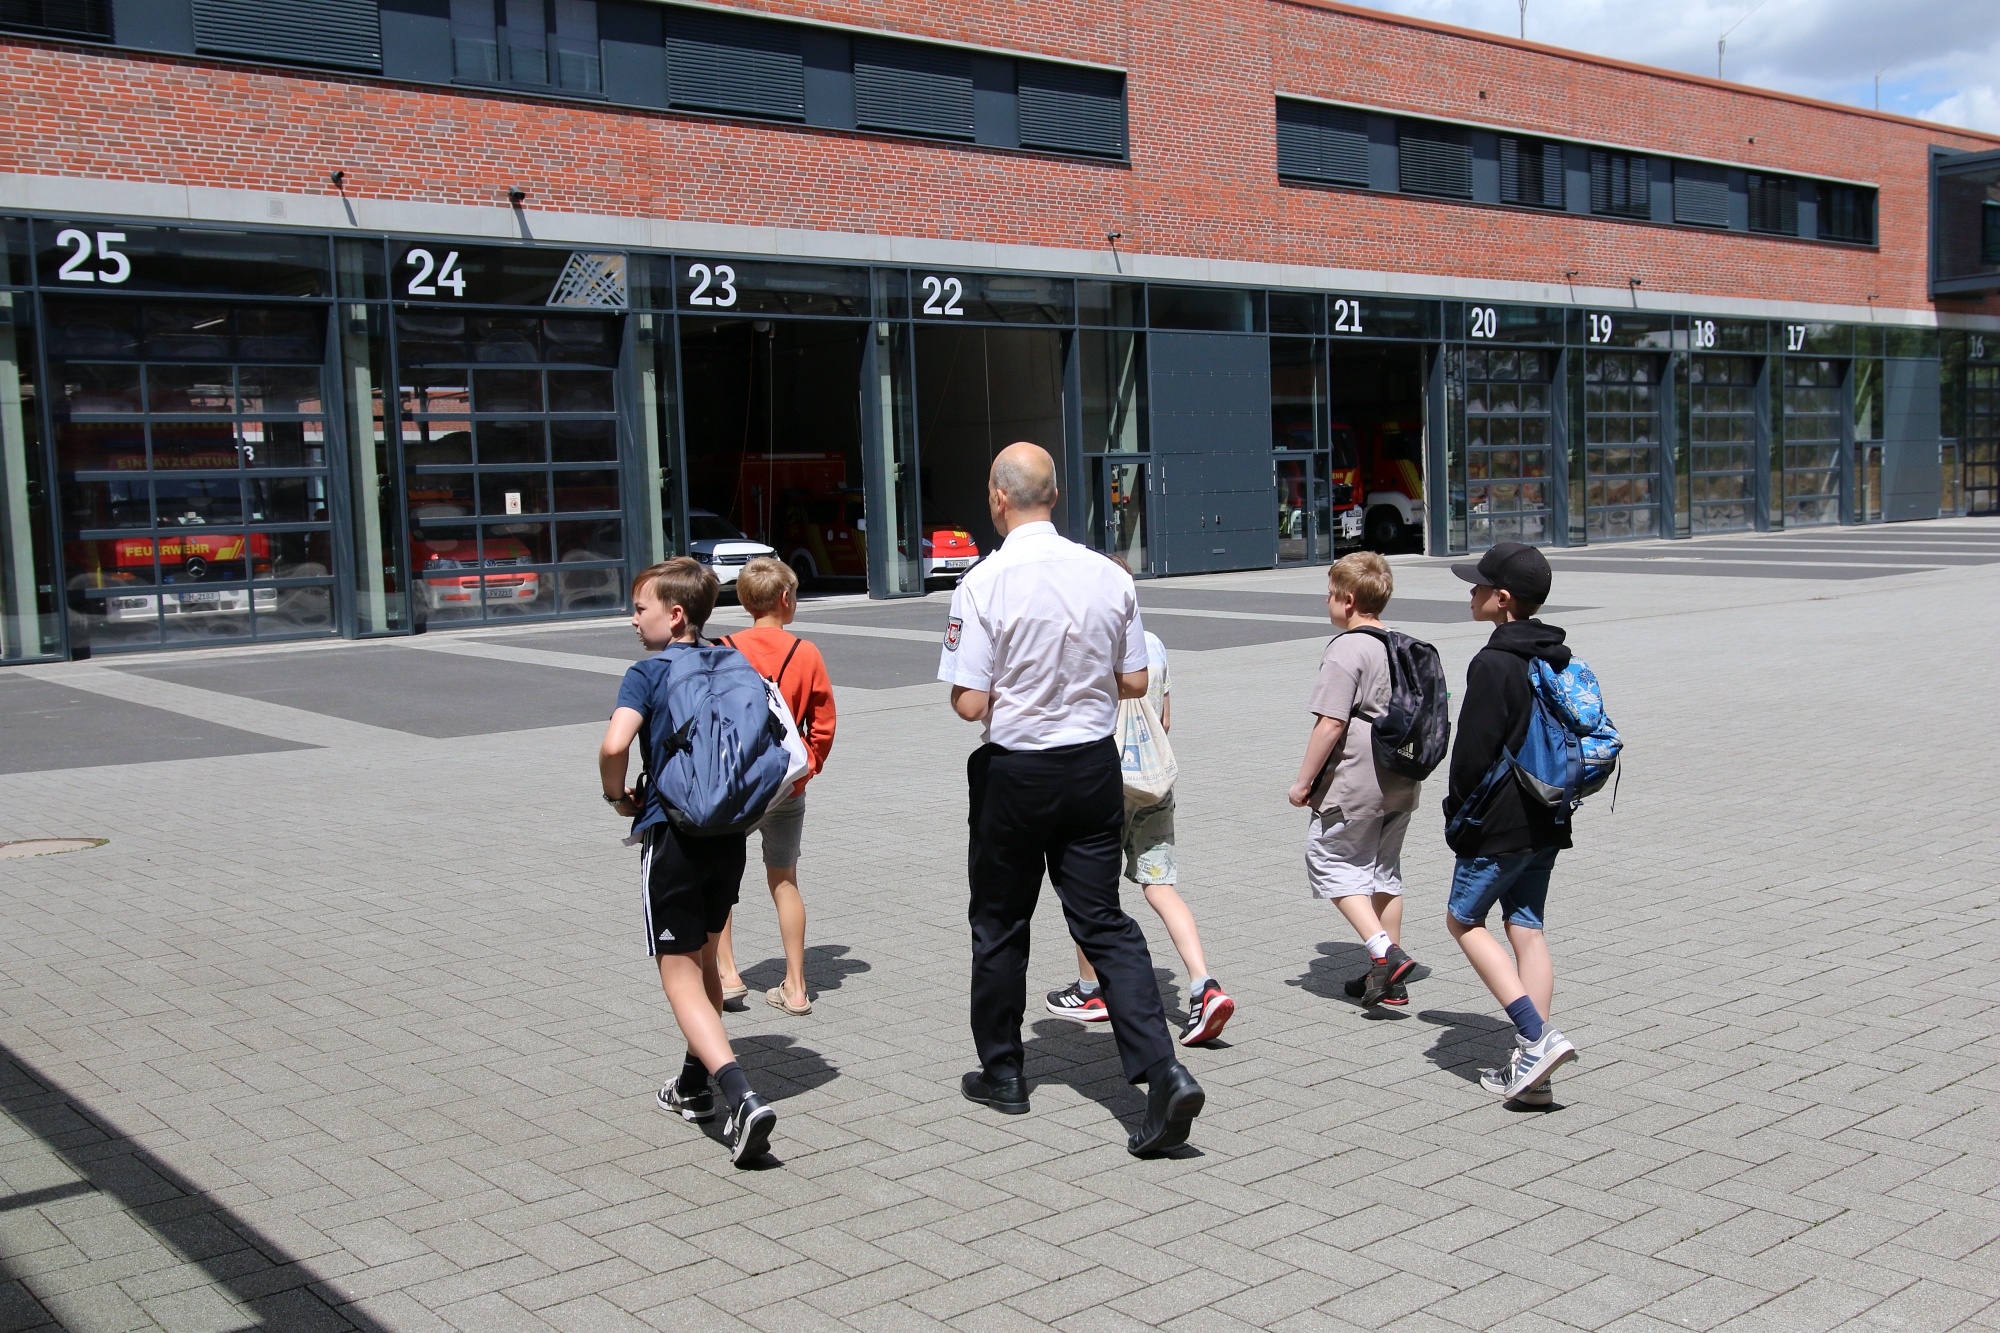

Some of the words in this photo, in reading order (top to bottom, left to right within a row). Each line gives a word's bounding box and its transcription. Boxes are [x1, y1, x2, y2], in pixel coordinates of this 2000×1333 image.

[57, 229, 131, 283] 25
[406, 248, 467, 297] 24
[688, 263, 737, 307] 23
[922, 276, 964, 316] 22
[1334, 299, 1363, 333] 21
[1471, 306, 1497, 338] 20
[1590, 314, 1612, 344] 19
[1695, 320, 1715, 348] 18
[1787, 325, 1805, 351] 17
[1970, 335, 1984, 358] 16
[125, 544, 210, 557] FEURWEHR
